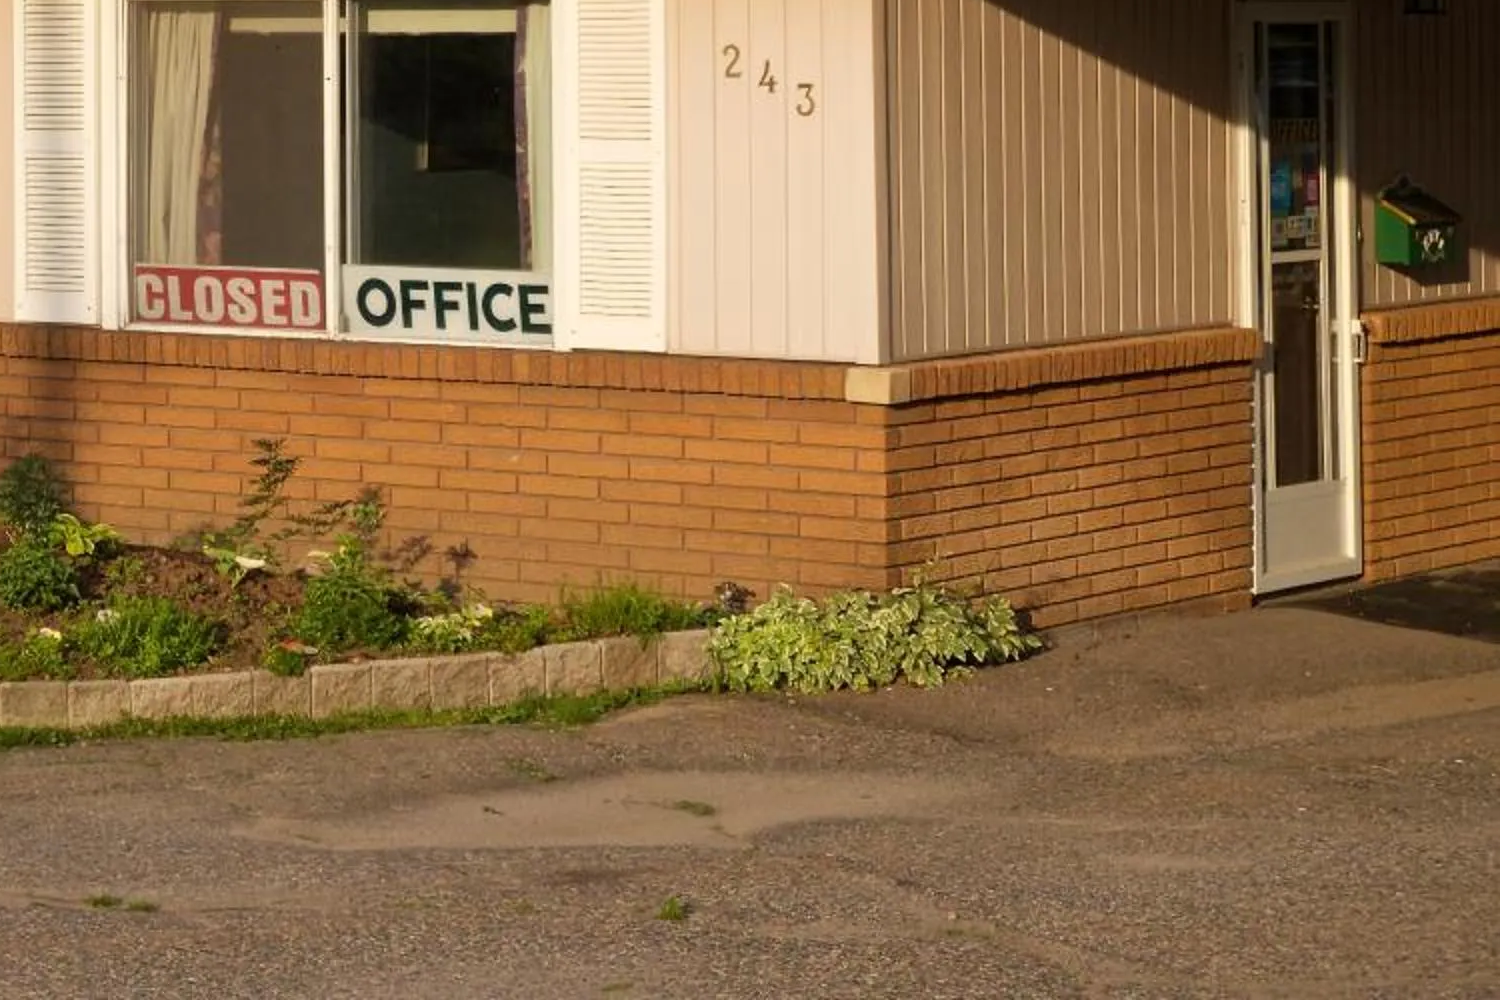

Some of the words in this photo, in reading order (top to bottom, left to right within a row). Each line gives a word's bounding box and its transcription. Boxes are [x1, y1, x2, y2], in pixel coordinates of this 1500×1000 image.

[722, 43, 816, 117] 243
[136, 273, 321, 327] CLOSED
[356, 277, 553, 335] OFFICE
